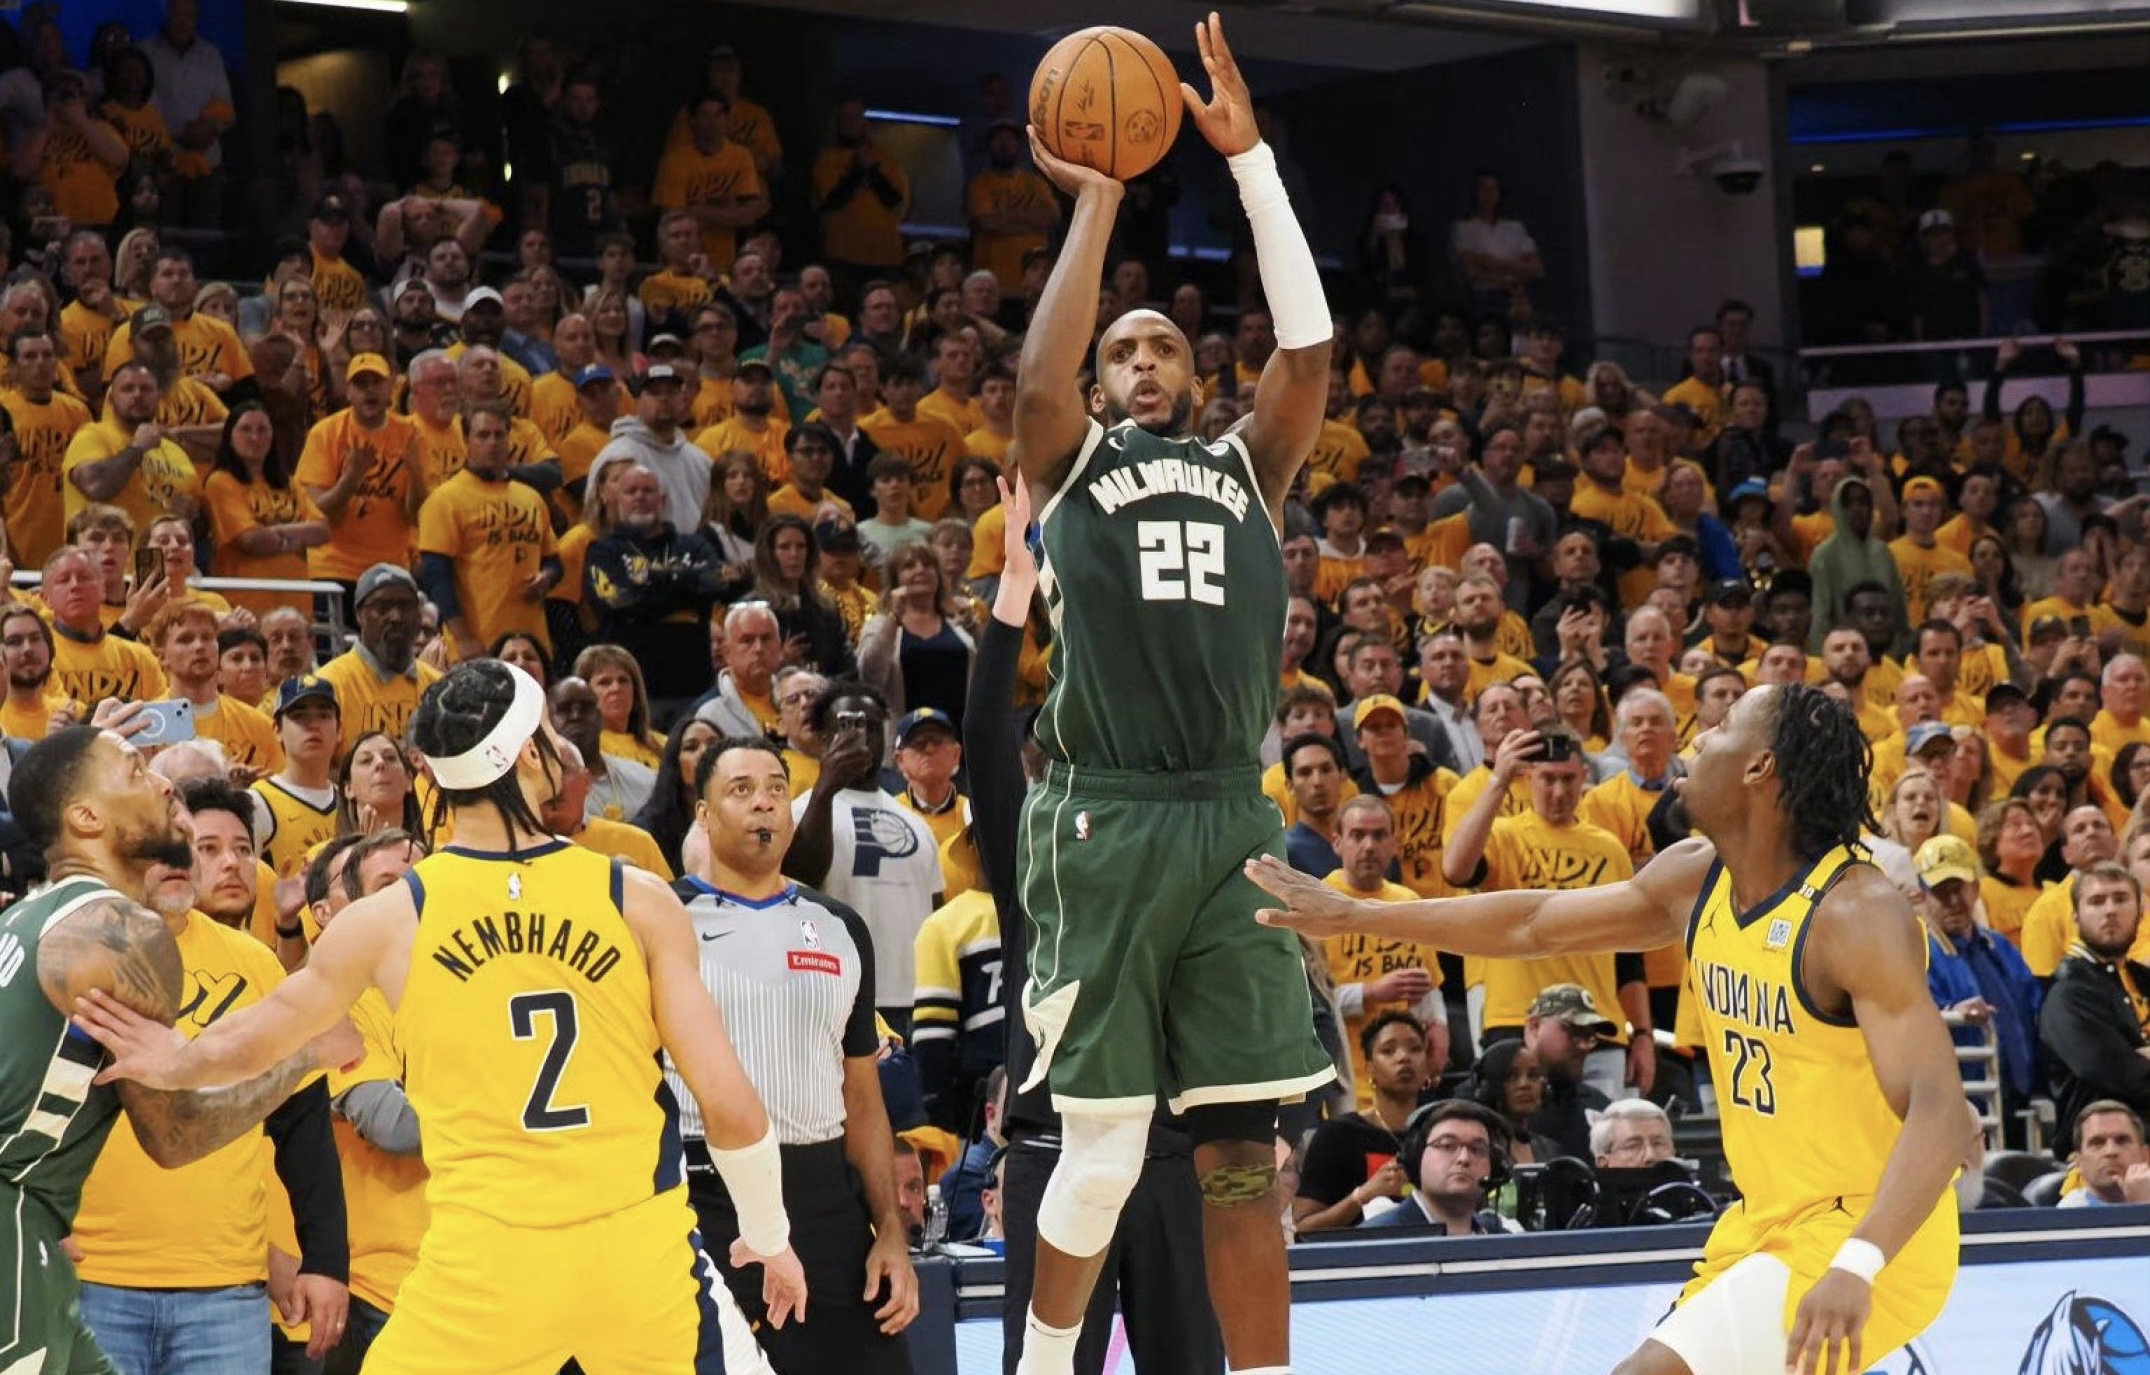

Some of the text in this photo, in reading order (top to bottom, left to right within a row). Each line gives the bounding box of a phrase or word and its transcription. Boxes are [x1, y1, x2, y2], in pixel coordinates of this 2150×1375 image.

[1088, 458, 1249, 524] MILWAUKEE
[1137, 520, 1225, 606] 22
[432, 911, 621, 984] NEMBHARD
[791, 954, 838, 971] Emirates
[1354, 956, 1373, 978] IS
[508, 989, 590, 1131] 2
[1724, 1028, 1776, 1116] 23
